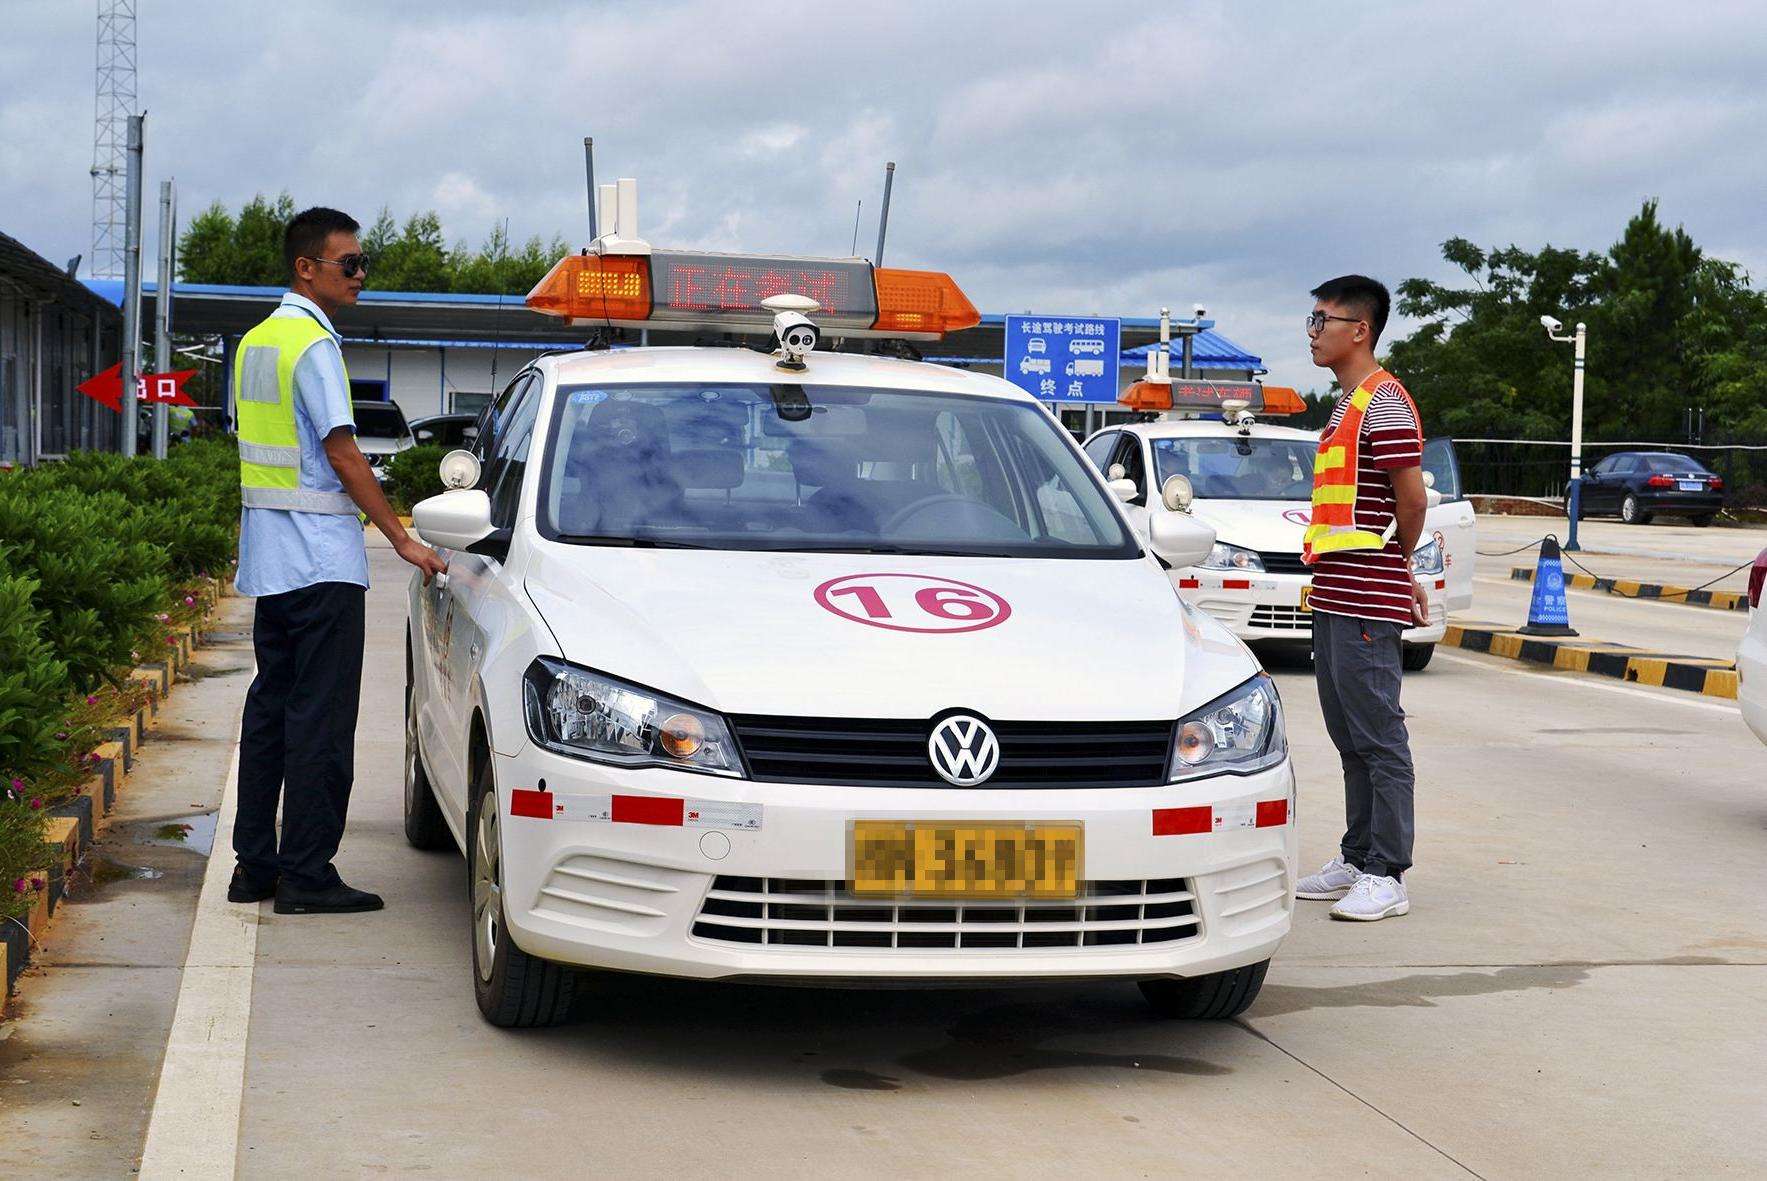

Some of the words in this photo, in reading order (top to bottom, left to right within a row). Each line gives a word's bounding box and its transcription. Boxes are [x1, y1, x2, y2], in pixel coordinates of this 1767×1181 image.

[1021, 321, 1105, 336] 长途驾驶考试路线
[1040, 379, 1084, 397] 终点
[830, 586, 995, 620] 16
